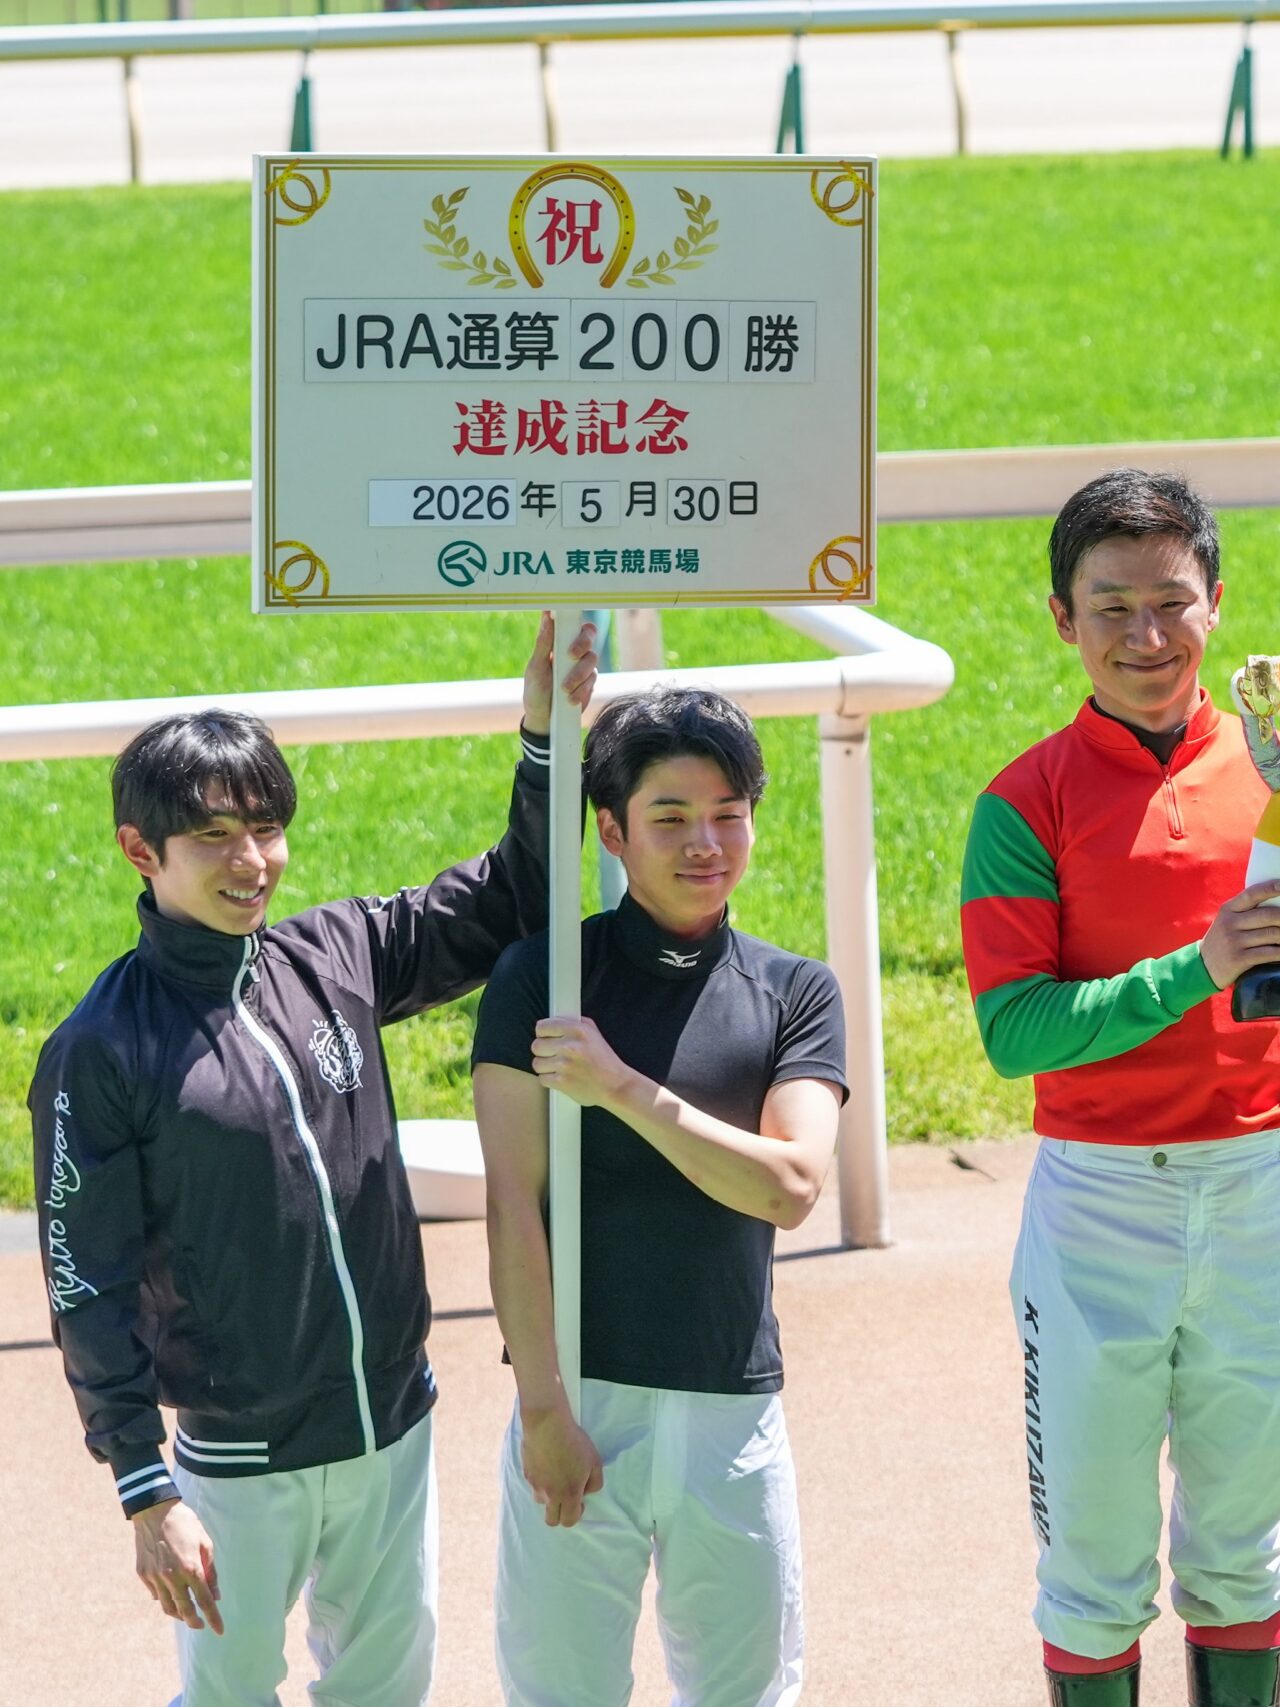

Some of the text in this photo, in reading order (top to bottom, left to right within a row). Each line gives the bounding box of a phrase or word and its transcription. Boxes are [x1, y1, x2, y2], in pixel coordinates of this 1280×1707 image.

[536, 197, 604, 266] 祝
[453, 399, 690, 456] 達成記念
[493, 548, 700, 577] JRA 東京競馬場
[1024, 1295, 1039, 1335] K
